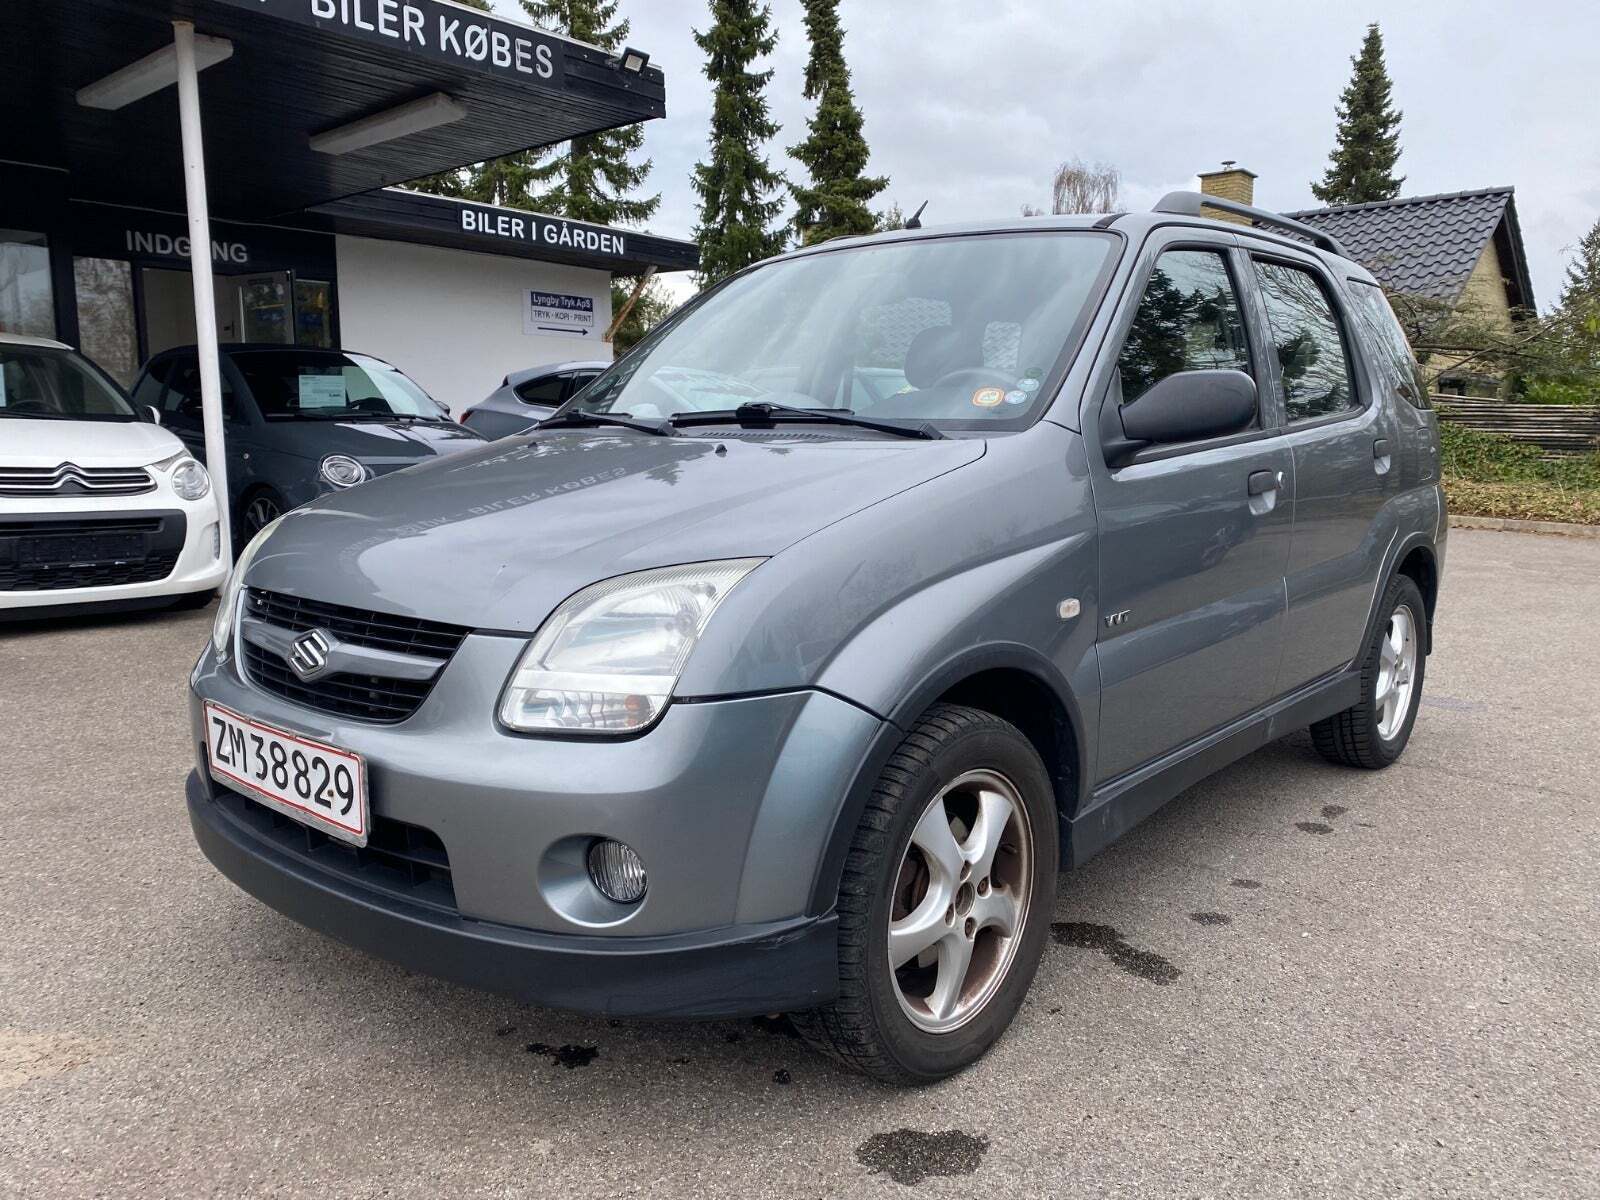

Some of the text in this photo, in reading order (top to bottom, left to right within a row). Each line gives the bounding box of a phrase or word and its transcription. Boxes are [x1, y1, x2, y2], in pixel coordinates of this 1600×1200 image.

[311, 0, 554, 79] BILER KØBES
[126, 229, 249, 263] INDGNG
[461, 209, 625, 255] BILER I GÅRDEN
[533, 292, 591, 309] Lyngby Tryk ApS
[533, 309, 592, 323] TRYK KOPI PRINT
